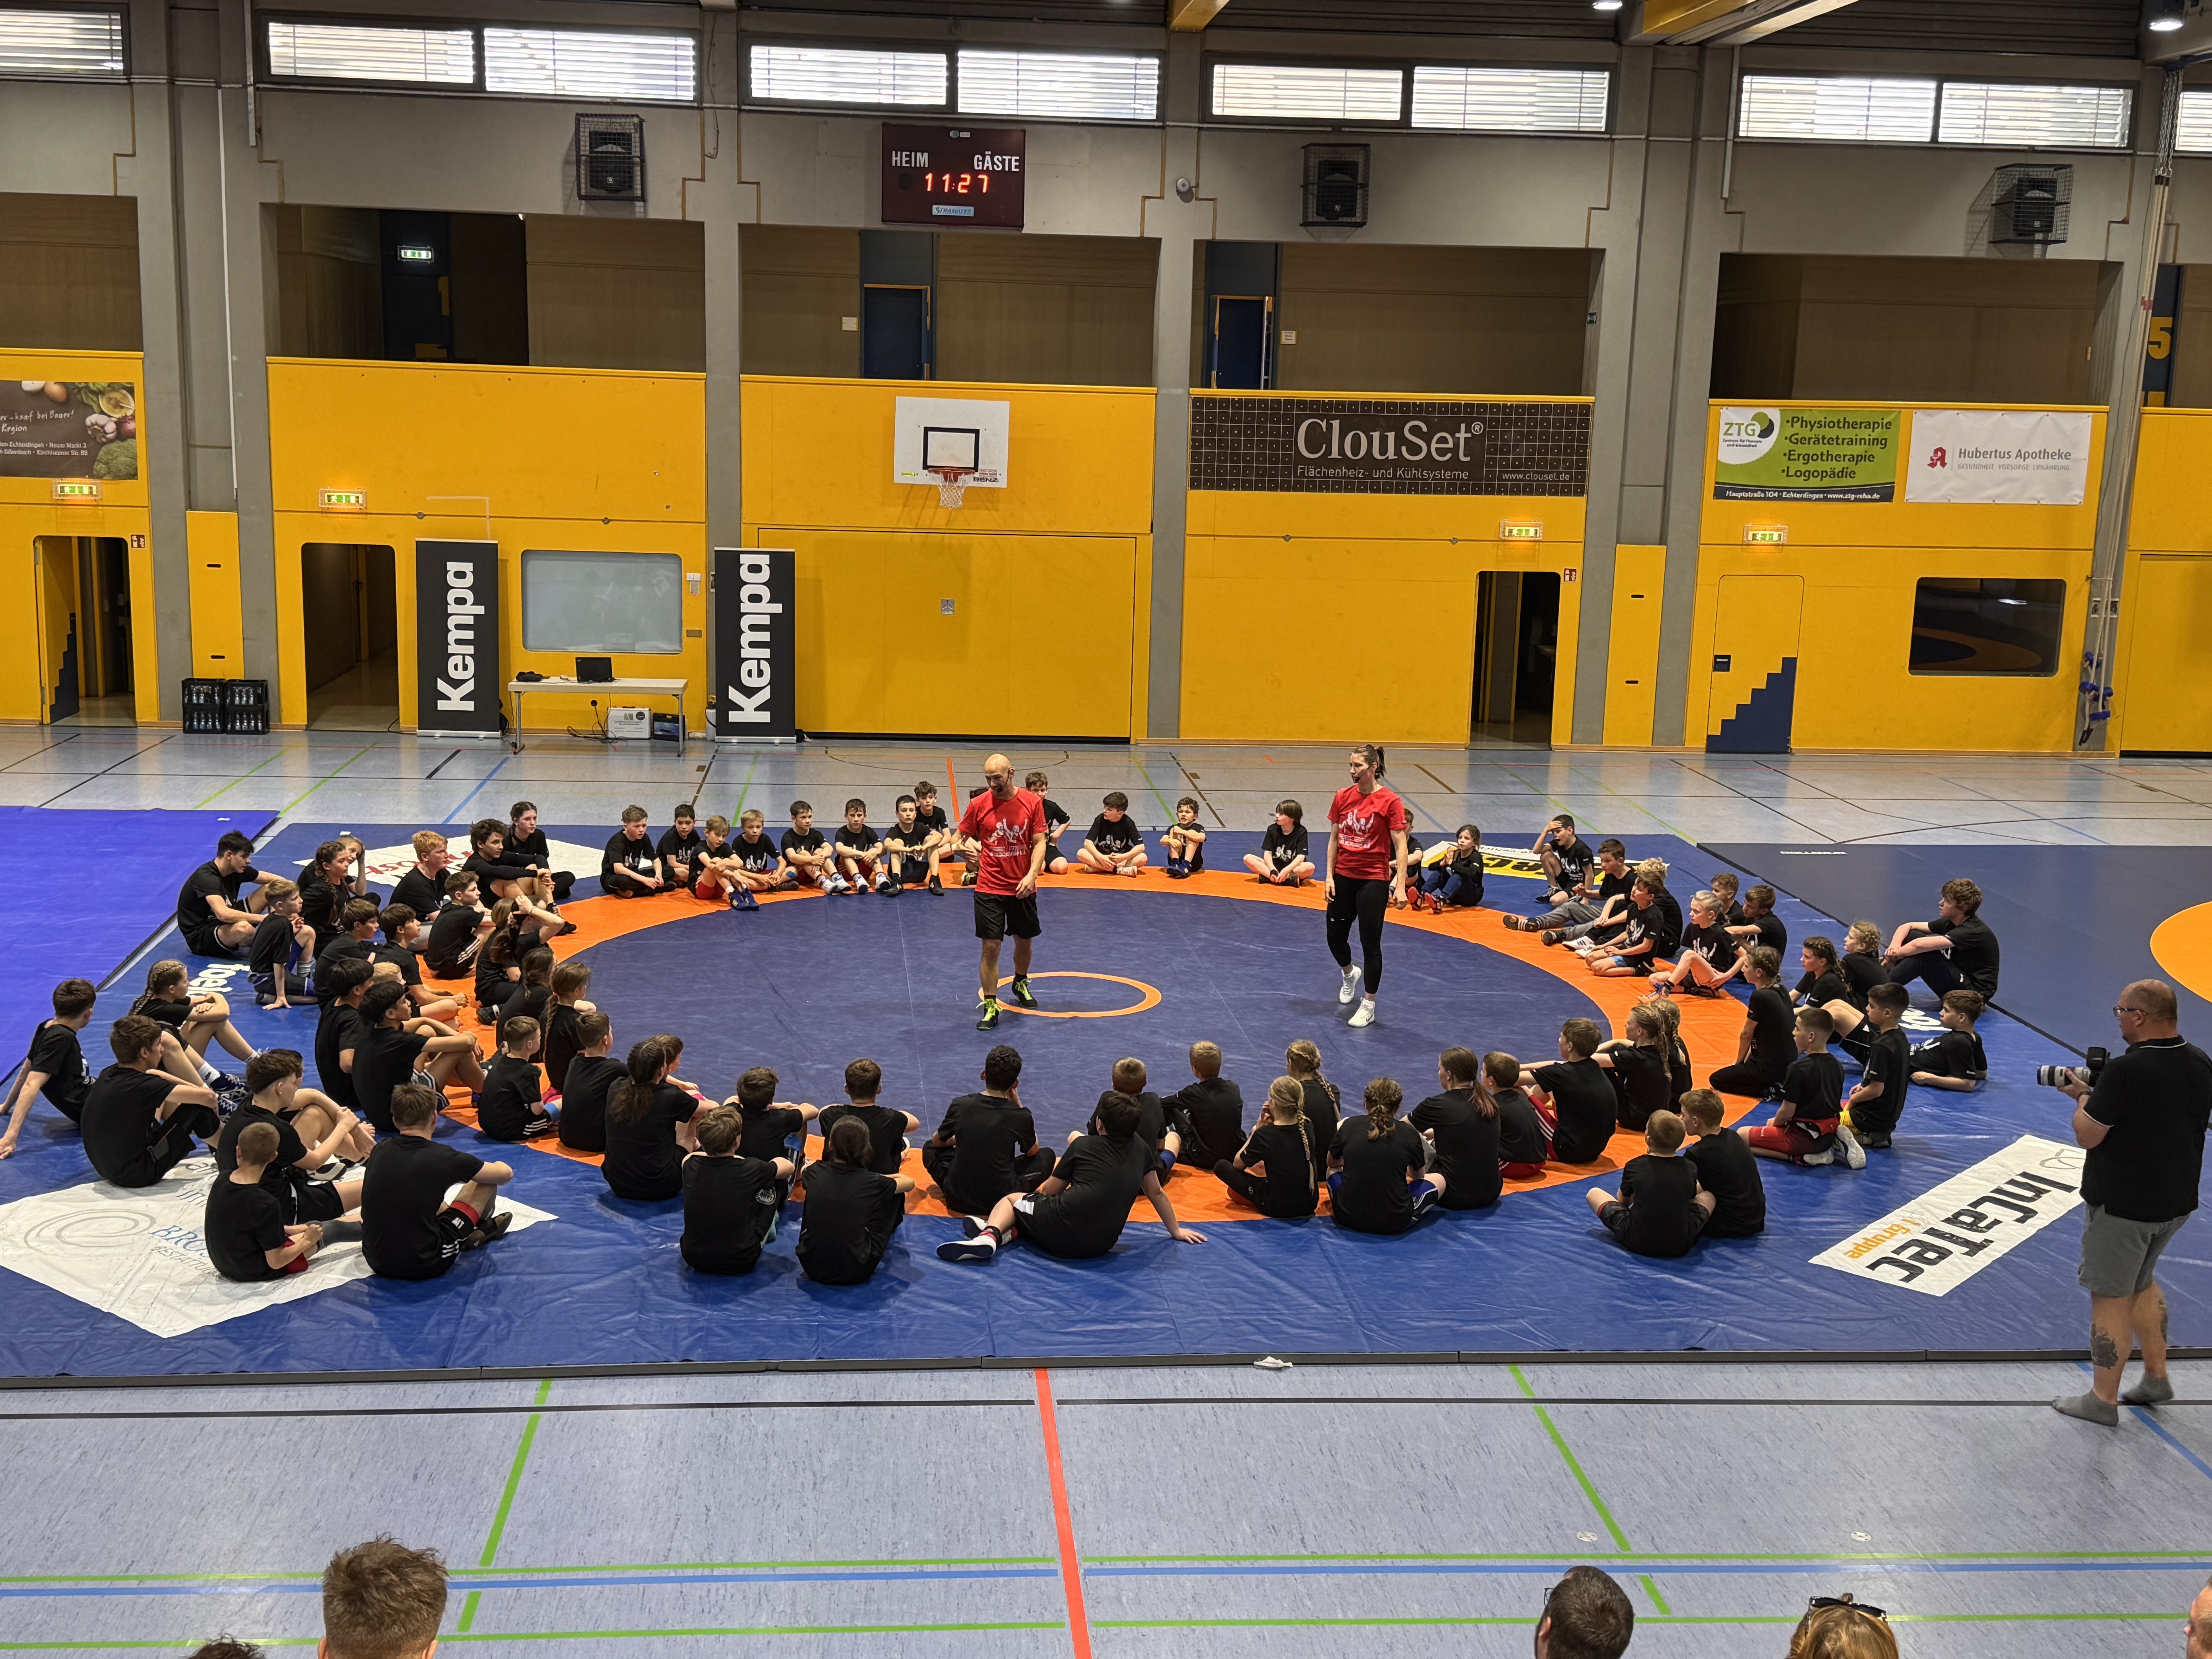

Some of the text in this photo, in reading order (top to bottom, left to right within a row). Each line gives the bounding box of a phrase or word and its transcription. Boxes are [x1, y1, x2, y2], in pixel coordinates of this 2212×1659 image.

[892, 151, 1019, 172] HEIM GÄSTE
[925, 173, 990, 193] 11:27
[2148, 317, 2173, 359] 5
[37, 410, 47, 419] bei
[2, 424, 27, 434] Region
[1723, 422, 1756, 436] ZTG
[1958, 448, 2071, 462] Hubertus Apotheke
[1297, 465, 1570, 481] Flächenheiz- und Kühlsysteme www.clouset.de
[1726, 490, 1764, 498] Hauptstraße
[1782, 491, 1823, 500] Echterdingen
[437, 562, 484, 711] Kempa
[728, 554, 782, 722] Kempa
